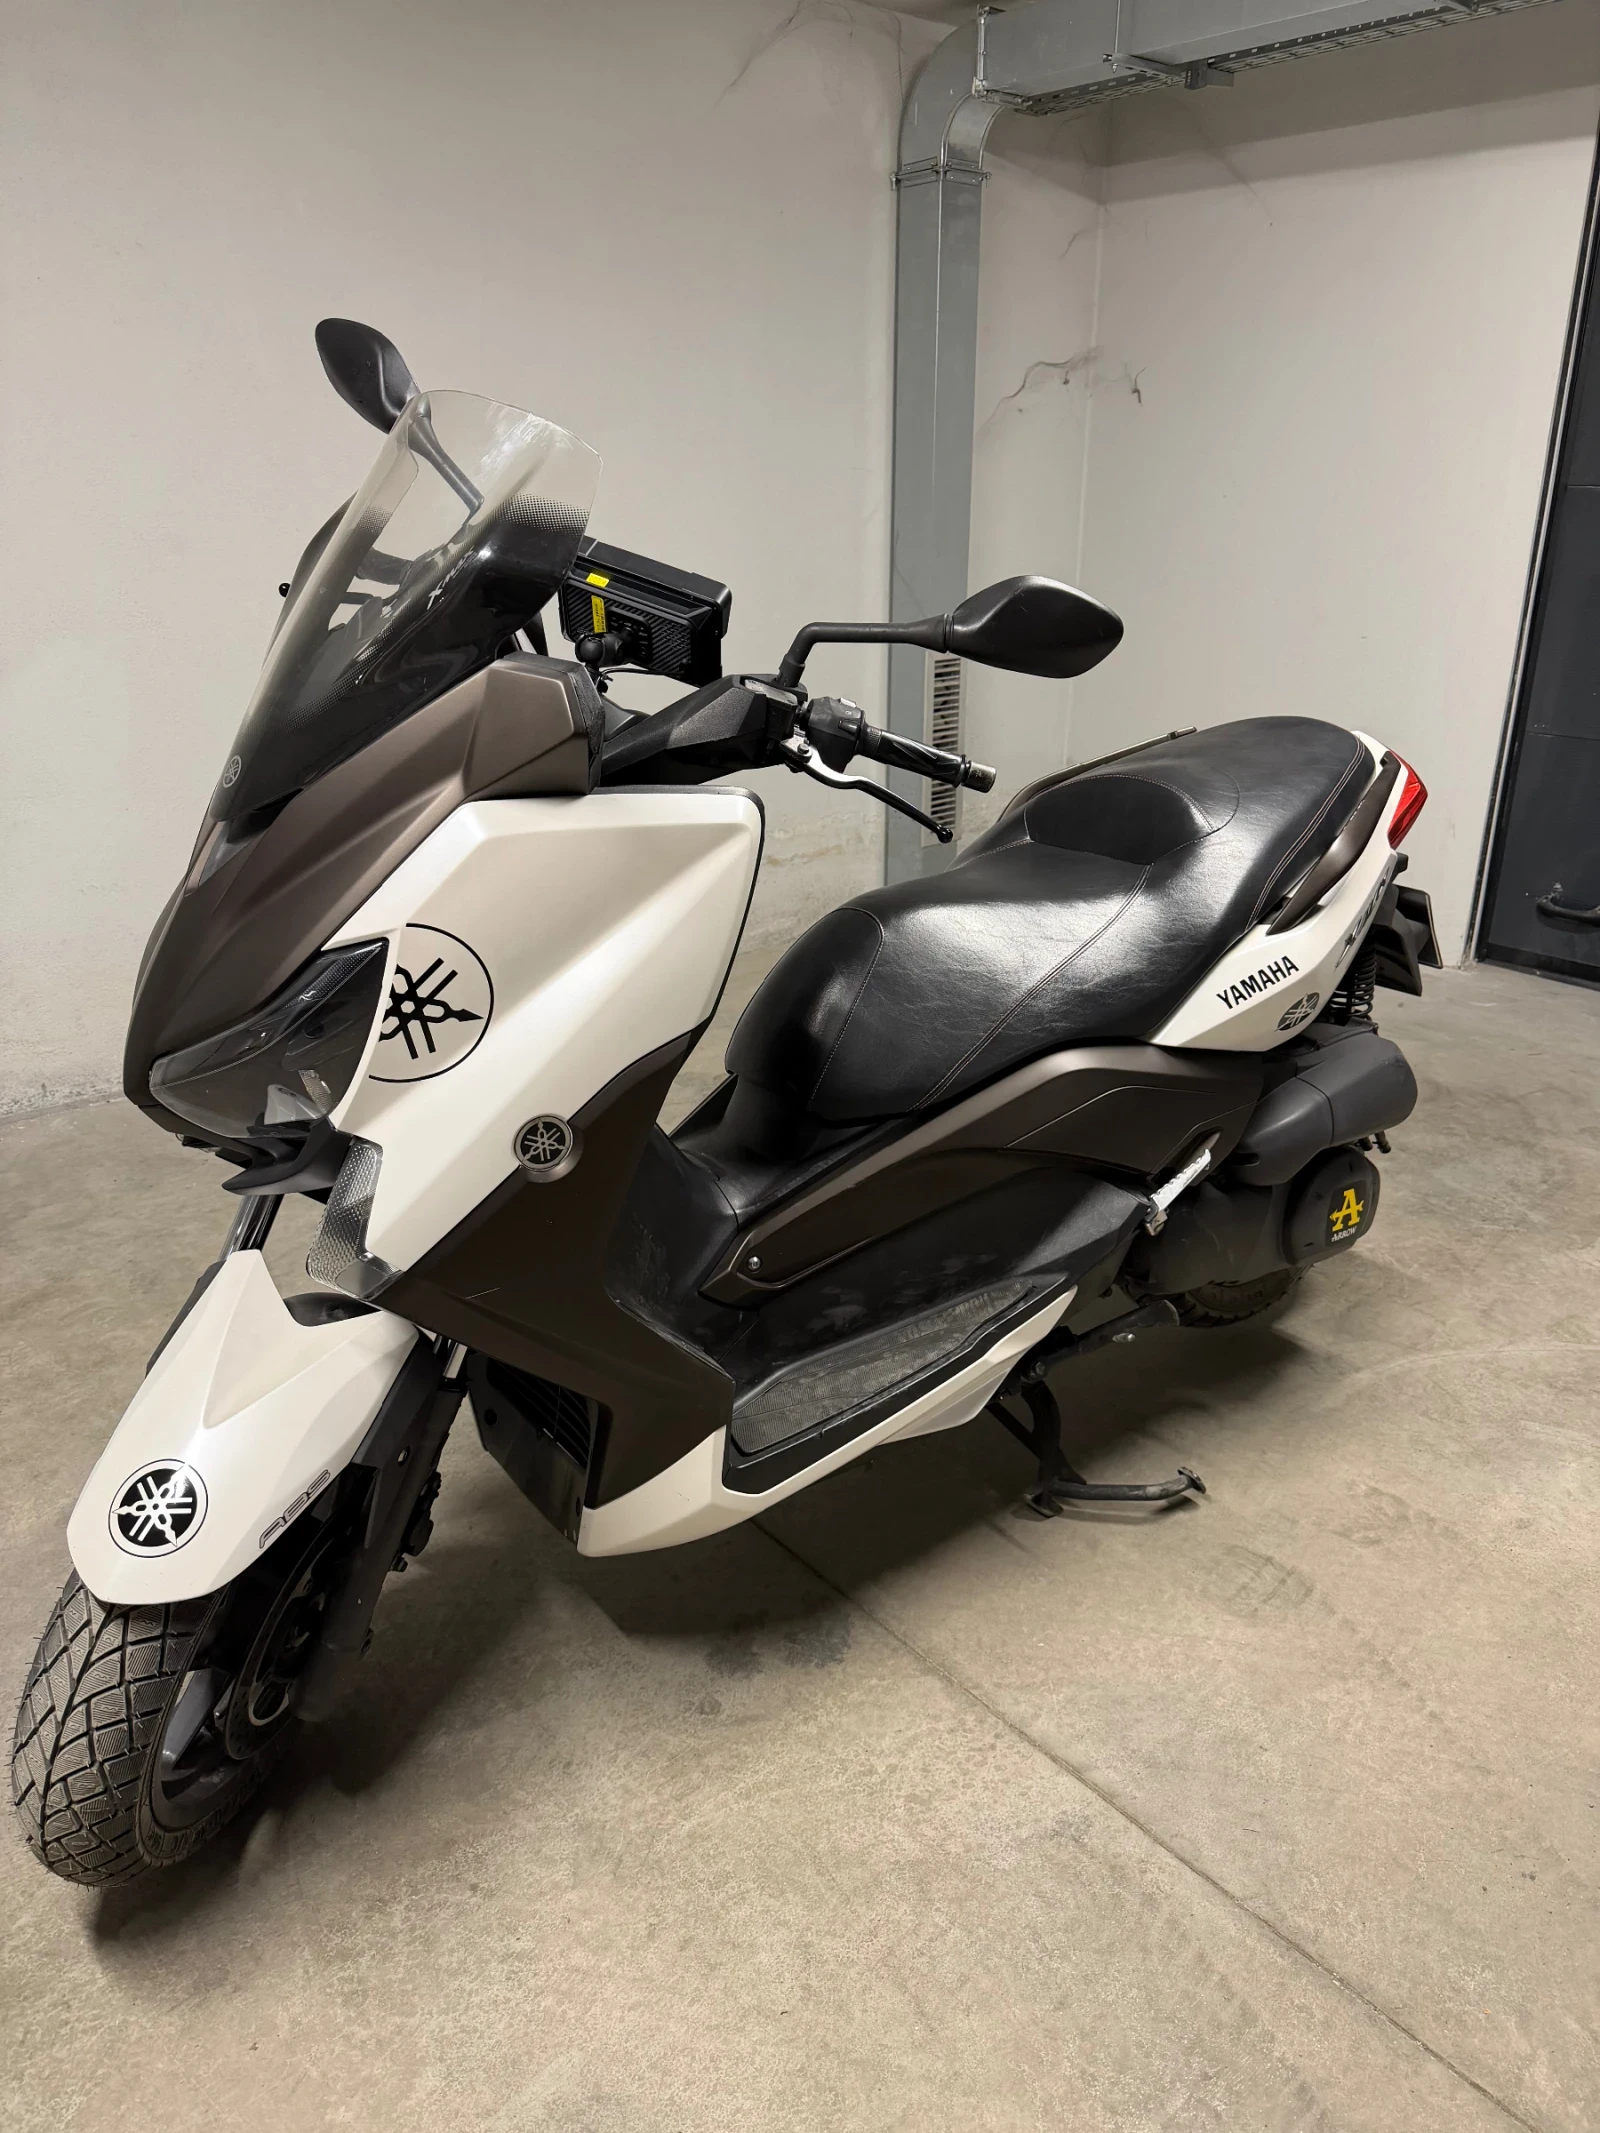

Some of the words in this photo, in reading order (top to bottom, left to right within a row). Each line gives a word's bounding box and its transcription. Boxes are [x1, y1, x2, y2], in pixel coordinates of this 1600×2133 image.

[1216, 955, 1300, 1009] YAMAHA
[1331, 1226, 1357, 1242] ARROW
[258, 1468, 331, 1549] ABS
